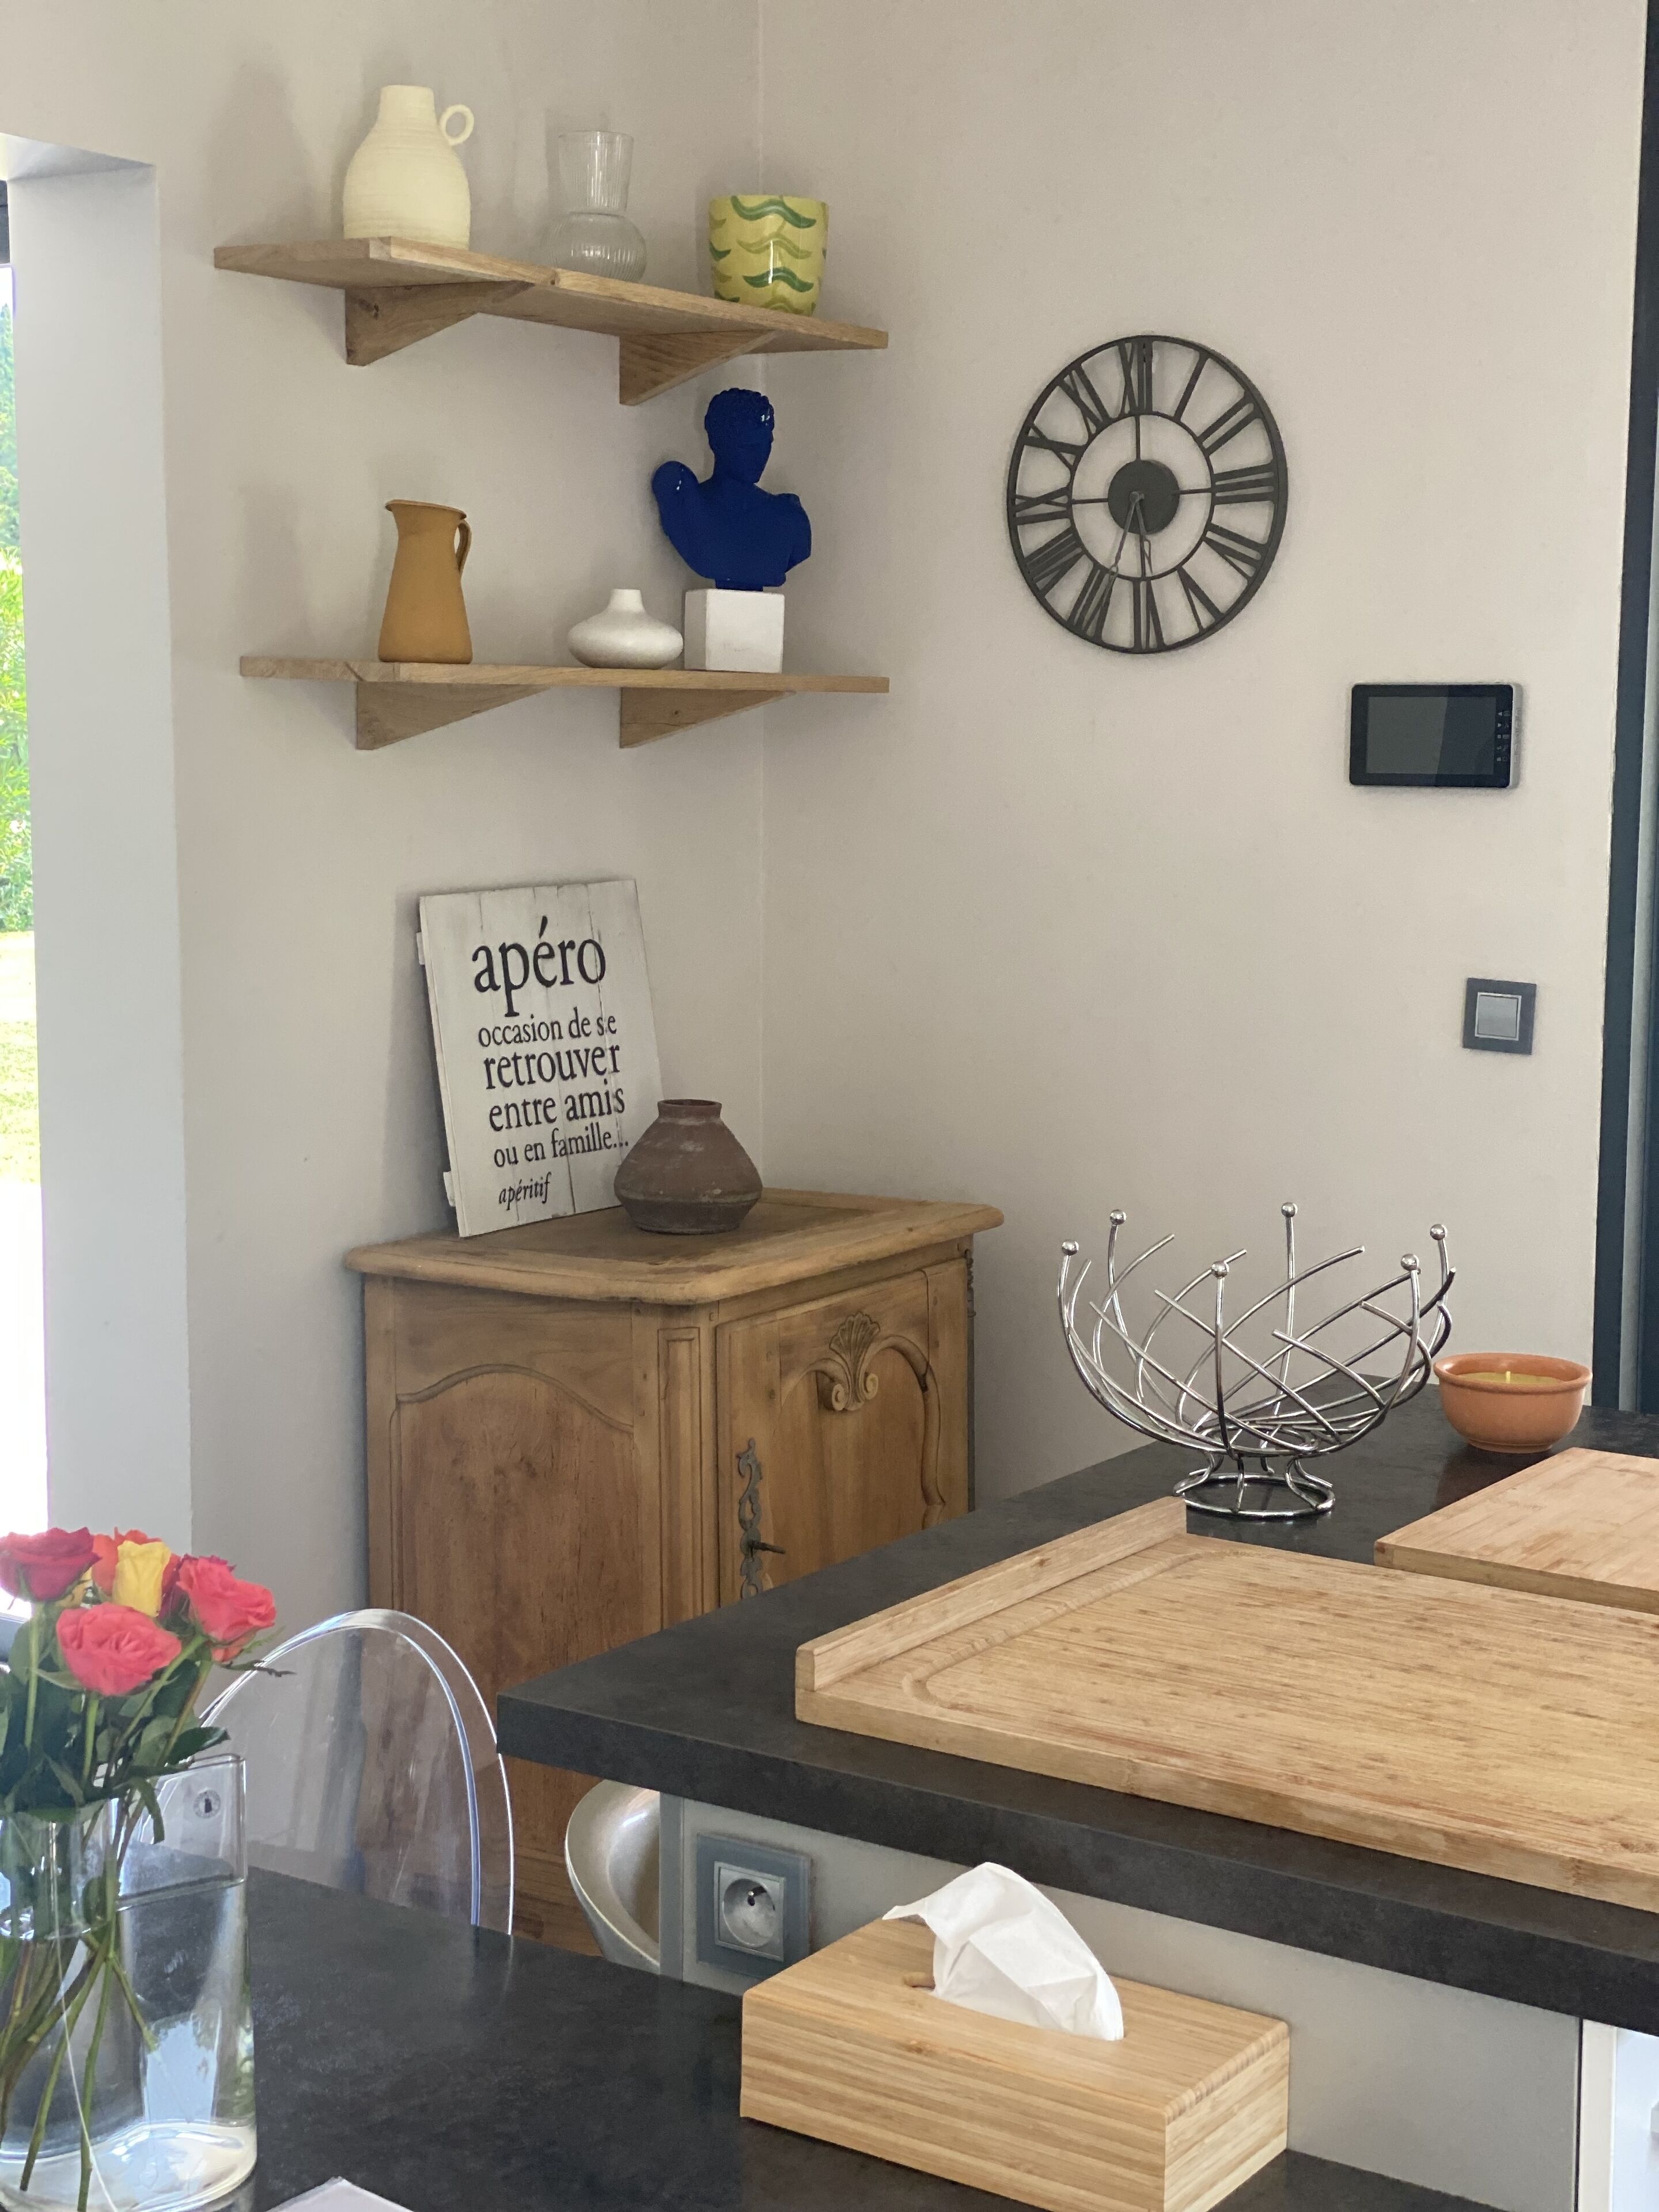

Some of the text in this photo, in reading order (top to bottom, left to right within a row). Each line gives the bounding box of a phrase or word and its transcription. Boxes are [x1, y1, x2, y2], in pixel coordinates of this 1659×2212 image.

[1055, 364, 1112, 433] XI
[1117, 341, 1153, 415] XII
[1022, 423, 1089, 469] X
[1197, 388, 1267, 459] II
[1210, 463, 1277, 505] III
[472, 915, 606, 1017] apéro
[478, 1006, 618, 1048] occasion de se
[483, 1044, 621, 1090] retrouver
[488, 1078, 626, 1132] entre amis
[494, 1121, 629, 1168] ou en famille...
[498, 1171, 552, 1211] apéritif
